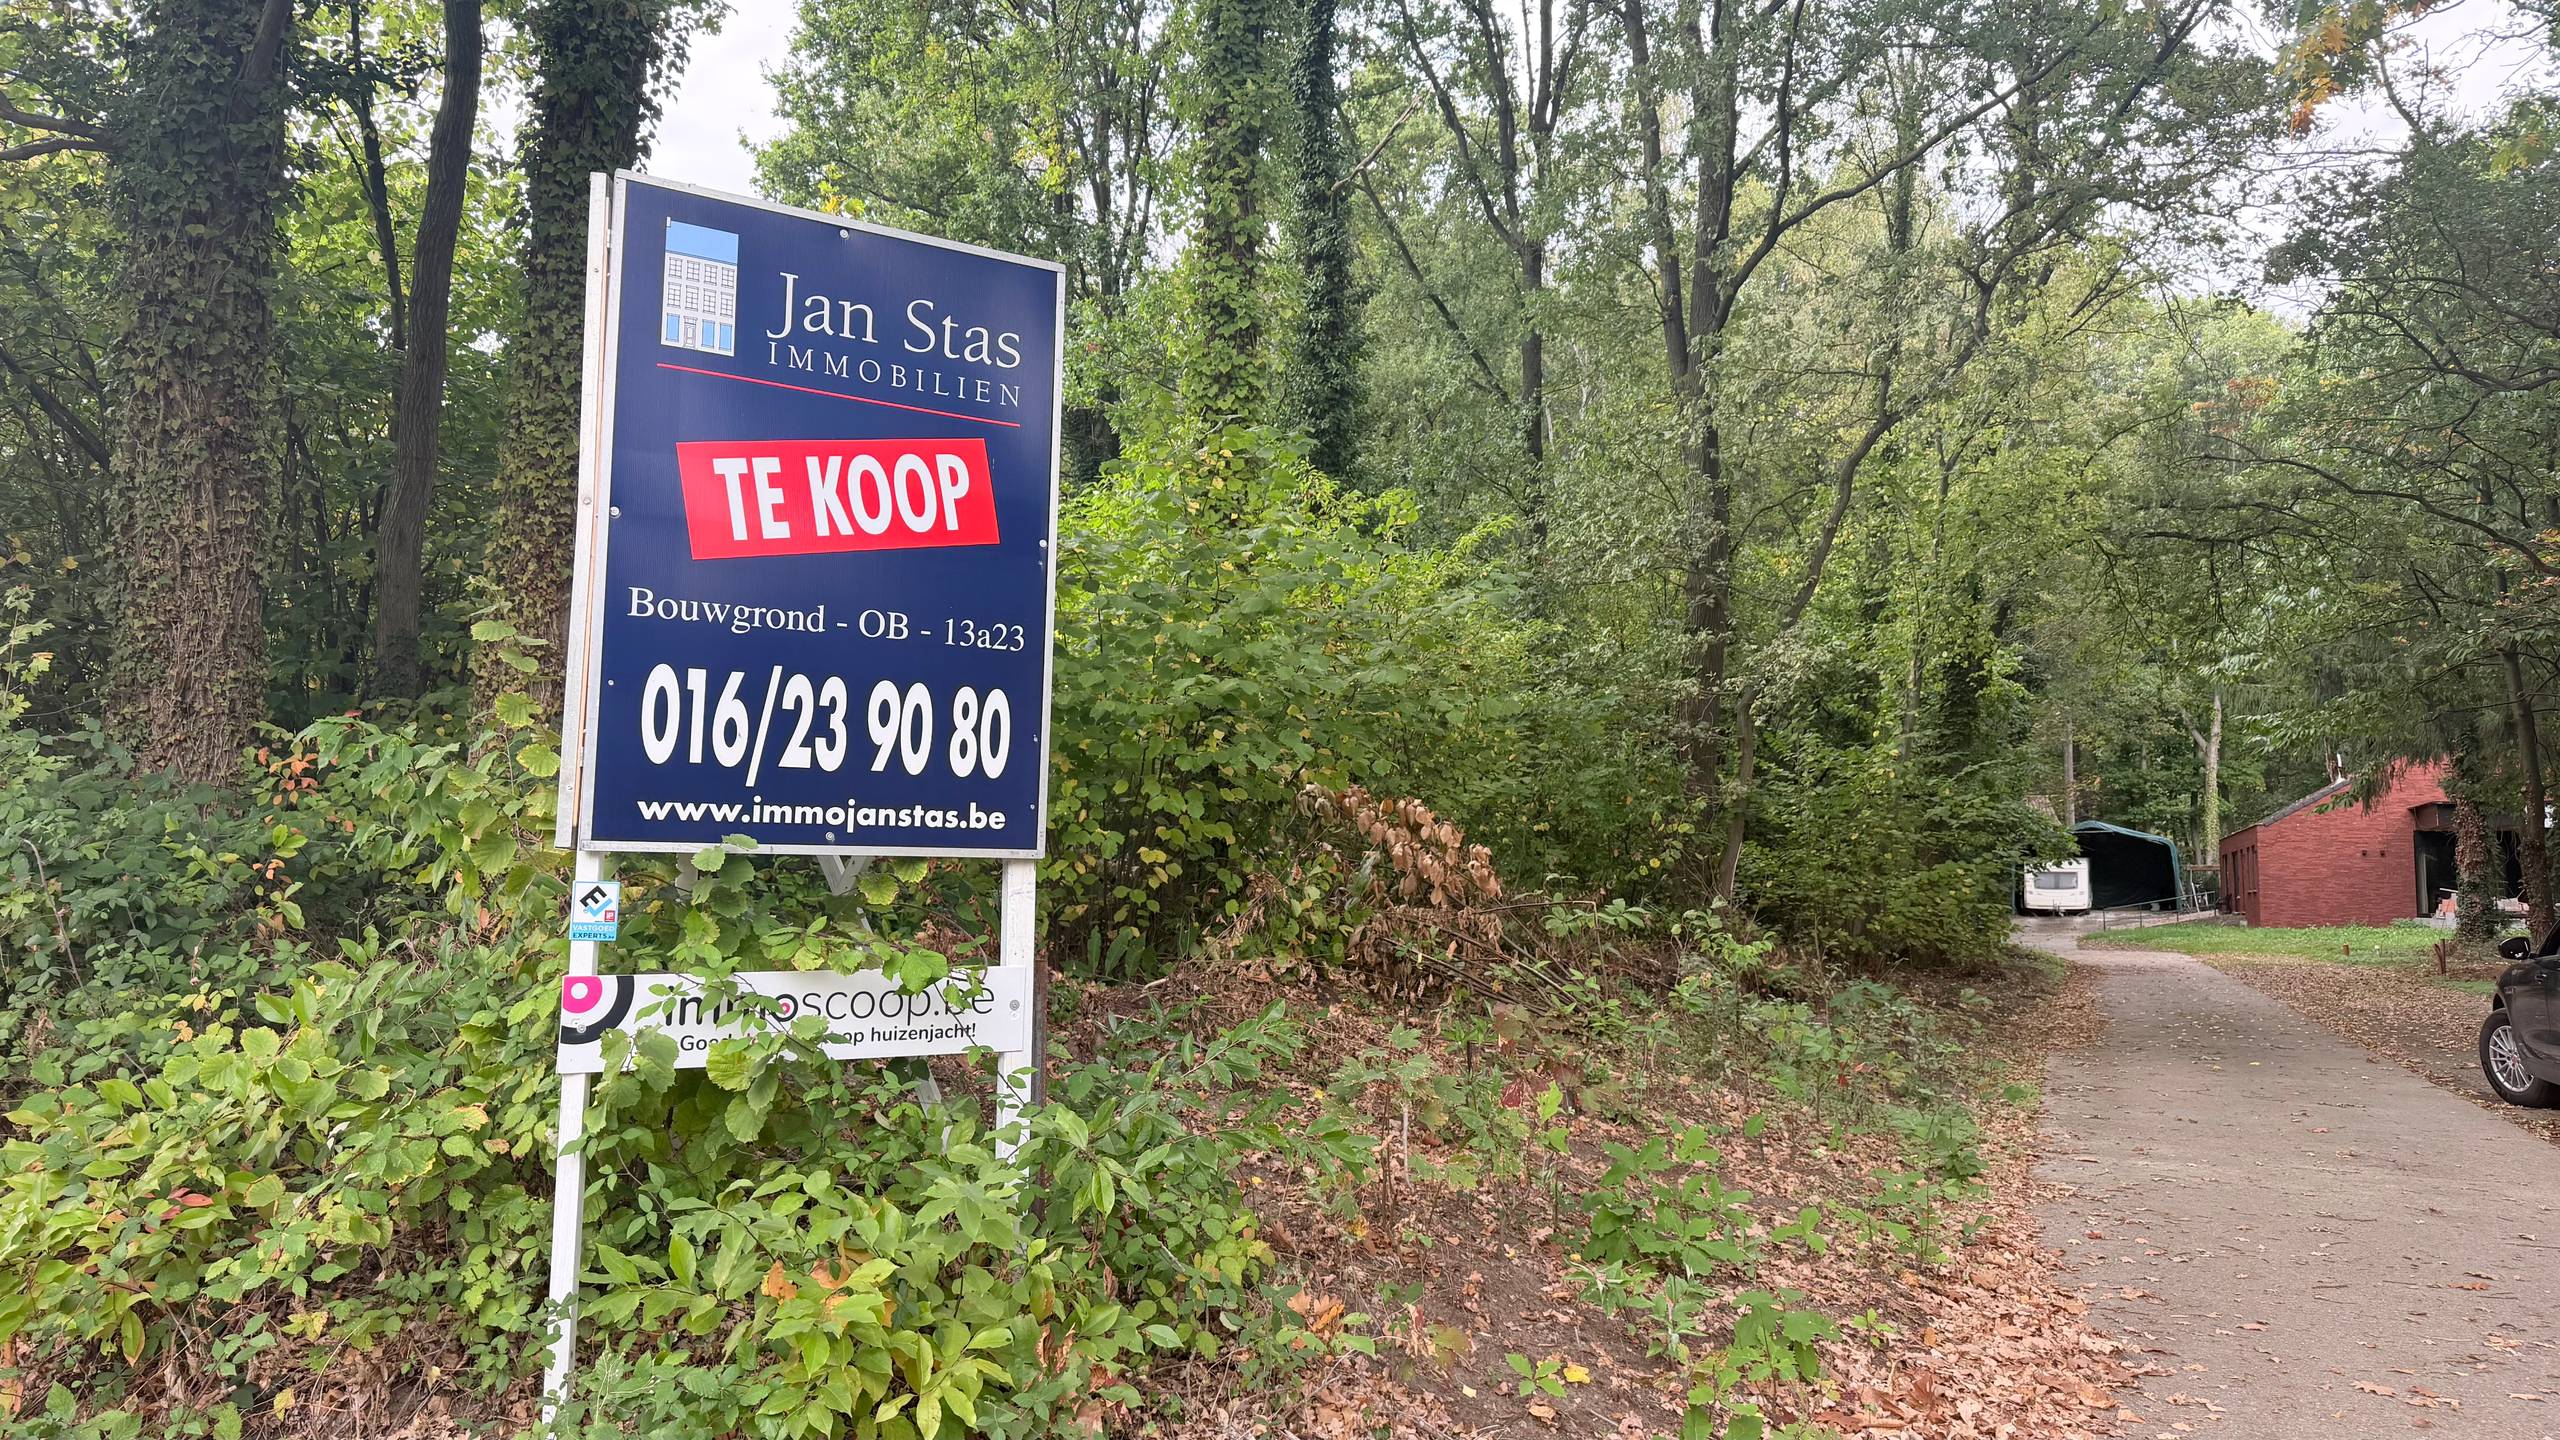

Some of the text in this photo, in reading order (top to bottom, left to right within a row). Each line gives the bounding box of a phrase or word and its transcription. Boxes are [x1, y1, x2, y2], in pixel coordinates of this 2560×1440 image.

[766, 272, 1021, 369] Jan Stas
[768, 341, 1021, 408] IMMOBILIEN
[712, 453, 970, 541] TE KOOP
[627, 586, 826, 634] Bouwgrond
[859, 609, 909, 640] OB
[944, 618, 1025, 652] 13a23
[641, 663, 1011, 787] 016/23 90 80
[637, 796, 1006, 834] www.immojanstas.be
[870, 1022, 977, 1043] huizenjacht!
